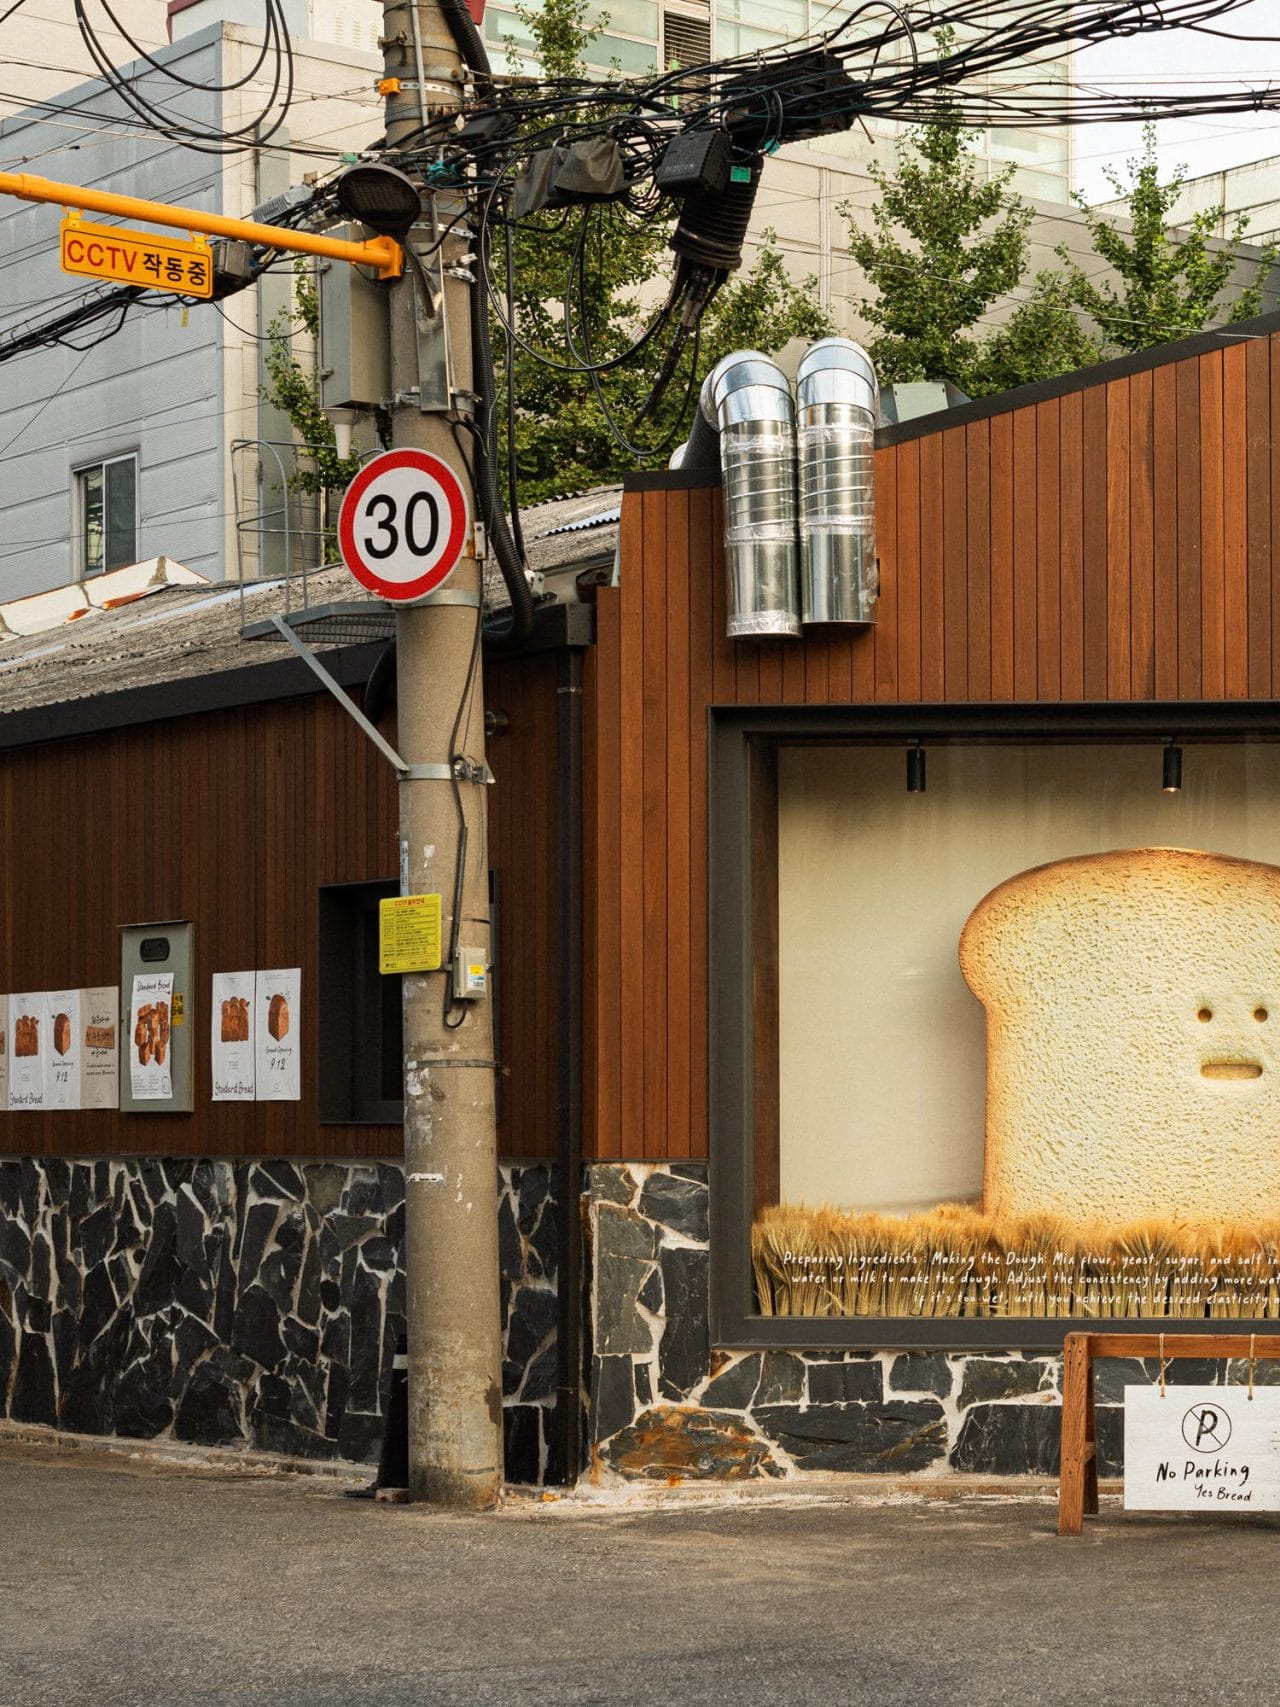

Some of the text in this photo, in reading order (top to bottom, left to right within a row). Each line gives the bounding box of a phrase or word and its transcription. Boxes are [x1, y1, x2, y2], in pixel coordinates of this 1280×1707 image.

[67, 239, 207, 287] CCTV 작동중
[364, 491, 439, 560] 30
[784, 1252, 844, 1270] Preparing
[849, 1252, 918, 1270] Ingredients
[932, 1252, 974, 1270] Making
[981, 1252, 1000, 1264] the
[1053, 1252, 1075, 1265] Mix
[1210, 1253, 1231, 1264] and
[1238, 1252, 1262, 1265] salt
[1268, 1253, 1278, 1265] in
[791, 1272, 826, 1284] water
[850, 1271, 876, 1283] milk
[882, 1272, 894, 1283] to
[900, 1272, 929, 1284] make
[936, 1272, 954, 1283] the
[1007, 1272, 1047, 1289] Adjust
[1054, 1272, 1073, 1284] the
[1079, 1273, 1149, 1288] consistency
[1154, 1273, 1168, 1288] by
[1174, 1273, 1217, 1291] adding
[1223, 1276, 1252, 1285] more
[914, 1291, 924, 1307] if
[931, 1291, 951, 1302] it's
[958, 1292, 975, 1302] too
[1015, 1292, 1044, 1303] until
[1050, 1296, 1072, 1307] you
[1076, 1292, 1121, 1304] achieve
[1128, 1292, 1147, 1304] the
[1153, 1292, 1200, 1304] desired
[1207, 1293, 1267, 1308] elasticity
[1156, 1459, 1250, 1487] No Parking
[1194, 1484, 1252, 1502] Yes Bread
